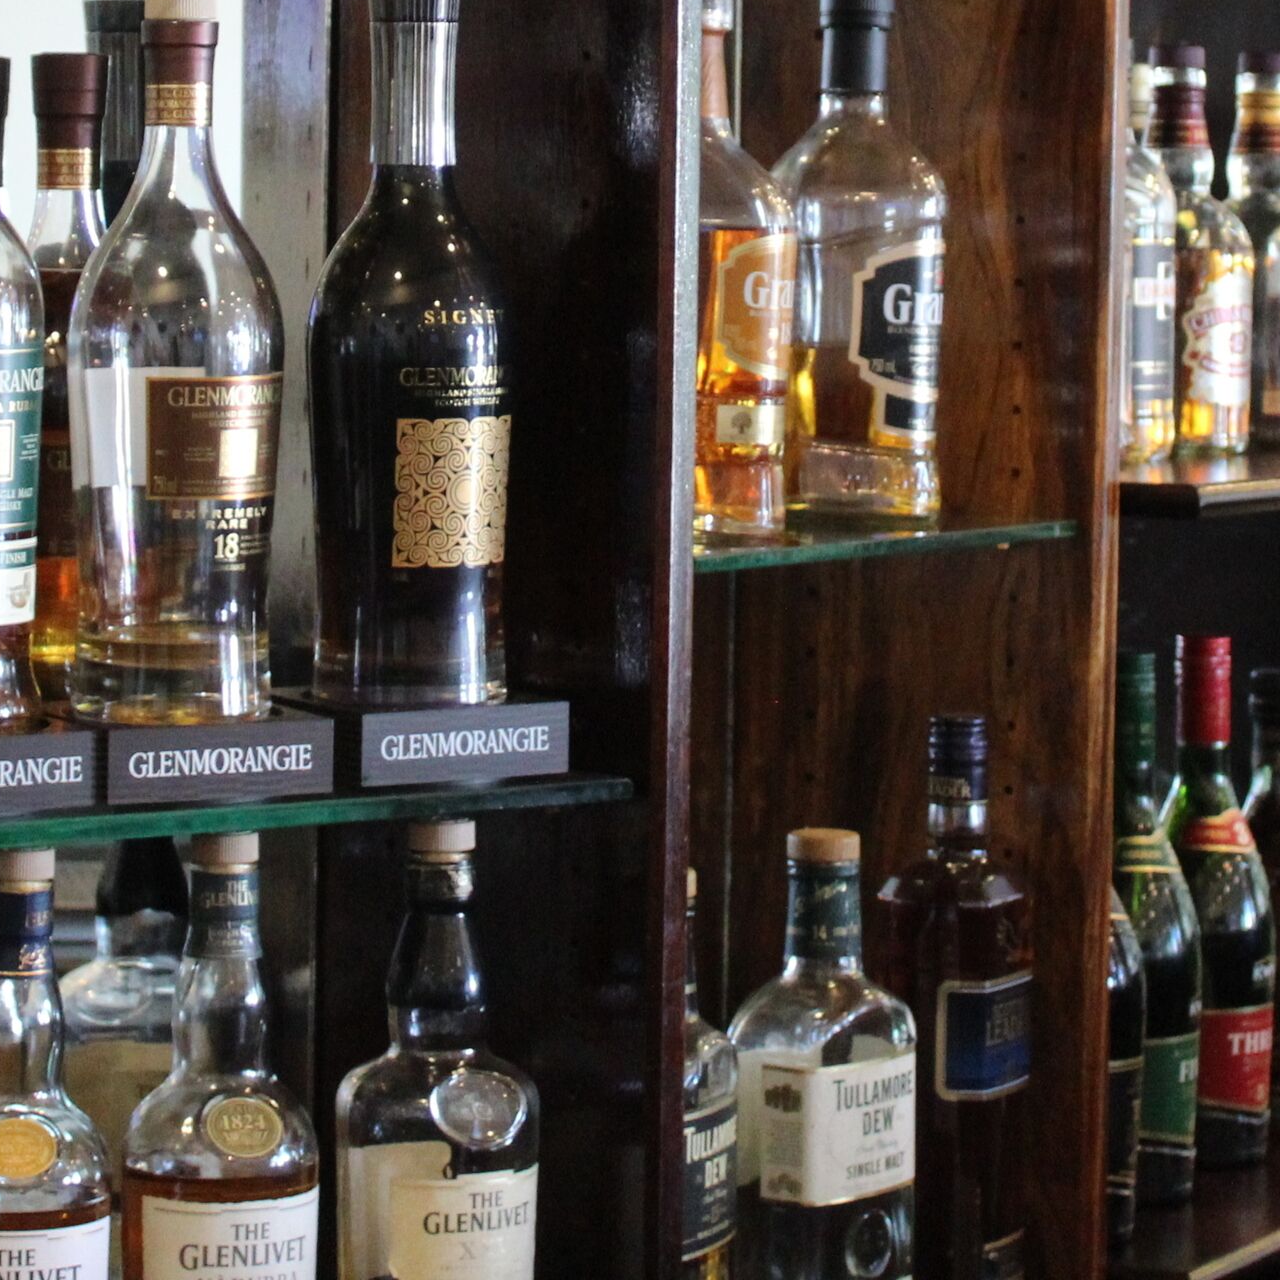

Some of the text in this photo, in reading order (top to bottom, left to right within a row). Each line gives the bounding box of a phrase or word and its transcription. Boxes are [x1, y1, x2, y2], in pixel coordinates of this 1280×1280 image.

[172, 507, 267, 519] EXTREMELY
[205, 519, 248, 529] RARE
[214, 532, 239, 559] 18
[380, 725, 550, 762] GLENMORANGIE
[129, 743, 313, 780] GLENMORANGIE
[833, 1070, 913, 1112] TULLAMORE
[223, 1114, 265, 1130] 1824
[863, 1105, 895, 1136] DEW
[846, 1152, 904, 1180] SINGLE MALT
[469, 1190, 503, 1209] THE
[231, 1222, 270, 1241] THE
[423, 1201, 529, 1235] GLENLIVET
[179, 1235, 305, 1270] GLENLIVET
